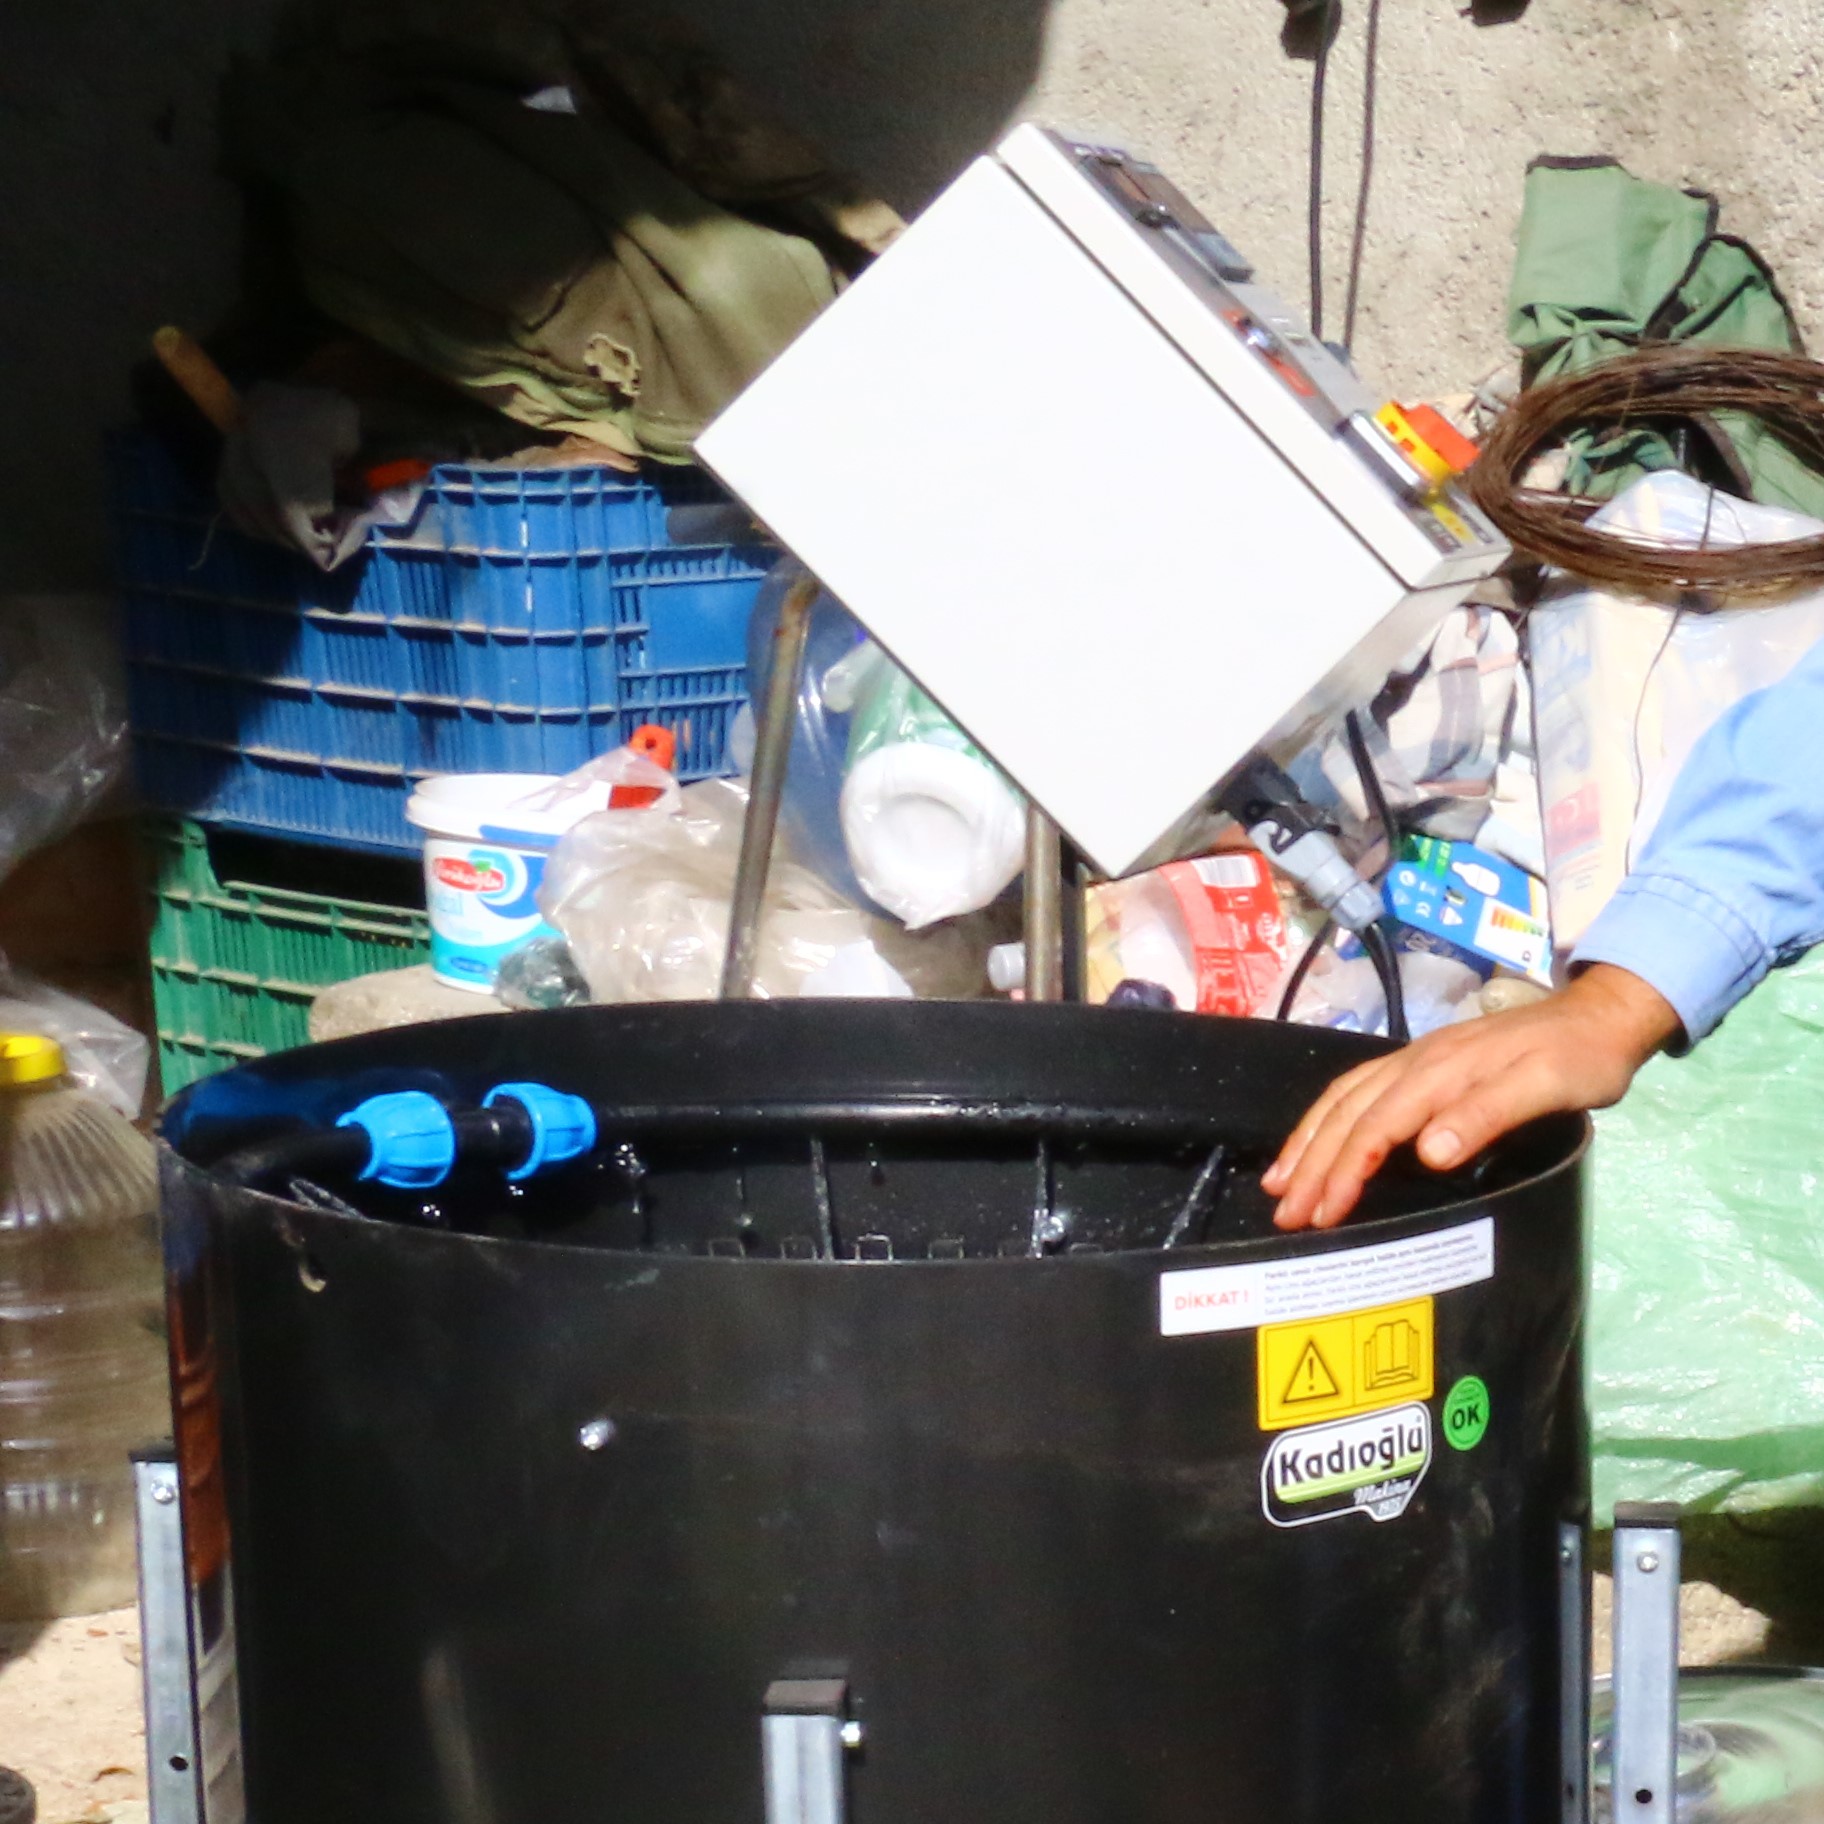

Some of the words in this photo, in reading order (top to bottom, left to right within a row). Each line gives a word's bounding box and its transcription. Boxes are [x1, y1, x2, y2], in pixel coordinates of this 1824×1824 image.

[1174, 1289, 1239, 1311] DİKKAT
[1452, 1402, 1480, 1430] OK
[1279, 1422, 1424, 1487] Kadıoğlu
